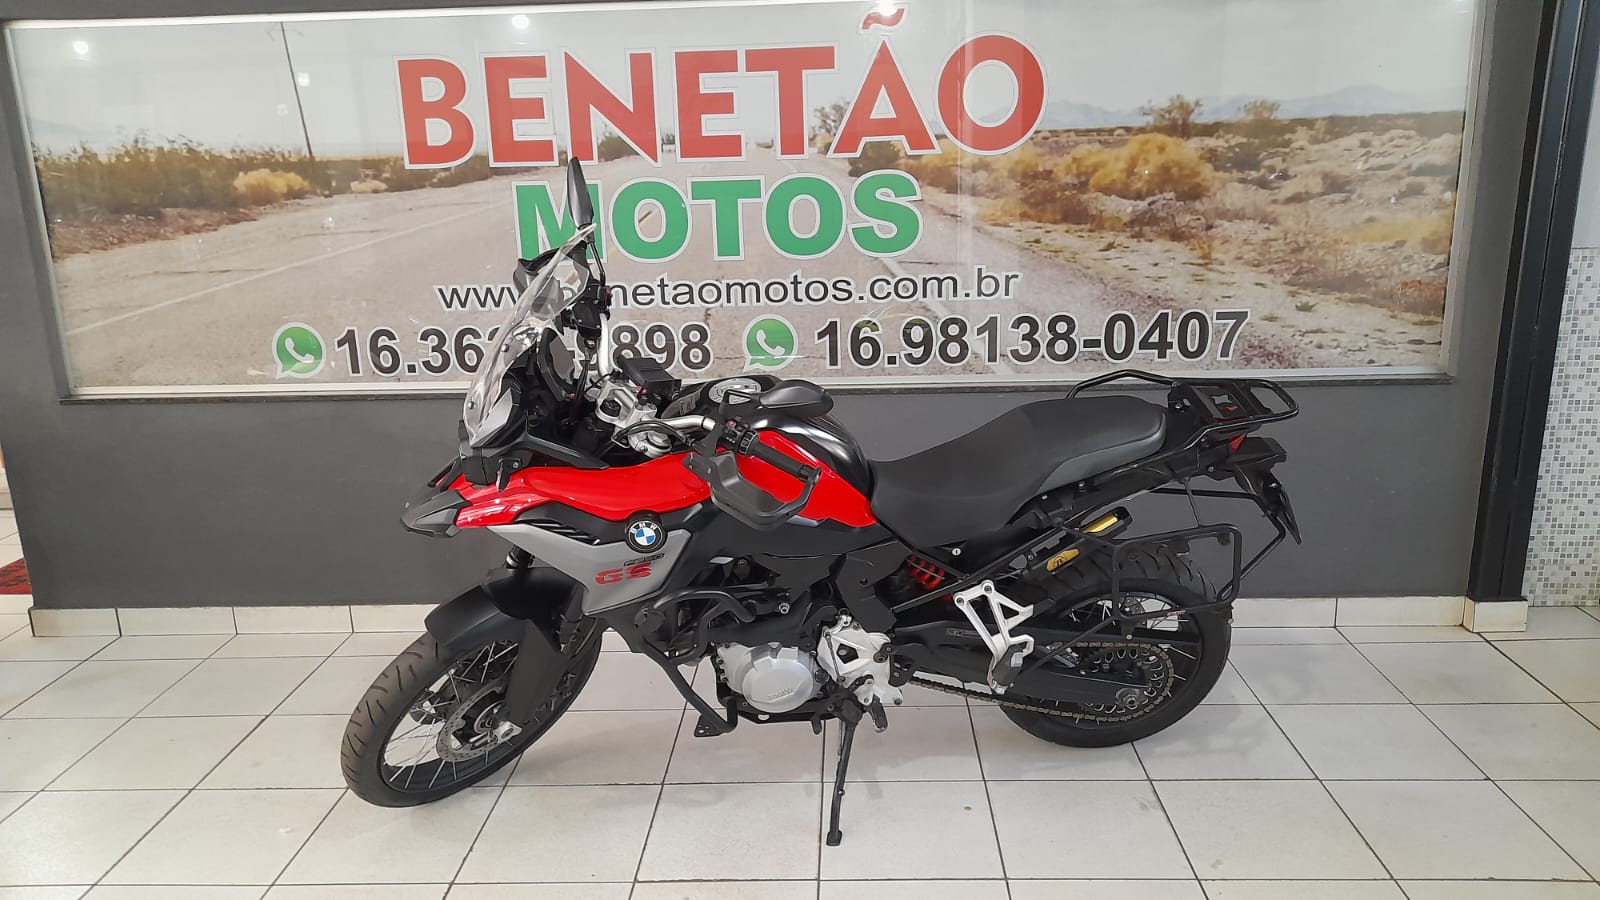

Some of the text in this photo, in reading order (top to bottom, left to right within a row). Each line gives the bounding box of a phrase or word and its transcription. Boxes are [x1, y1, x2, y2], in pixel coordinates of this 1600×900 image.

[397, 8, 1045, 168] BENETÃO
[515, 174, 921, 262] MOTOS
[437, 267, 1019, 308] wwbnetaomotos.com.br
[817, 311, 1250, 367] 16.98138-0407
[595, 561, 652, 585] GS
